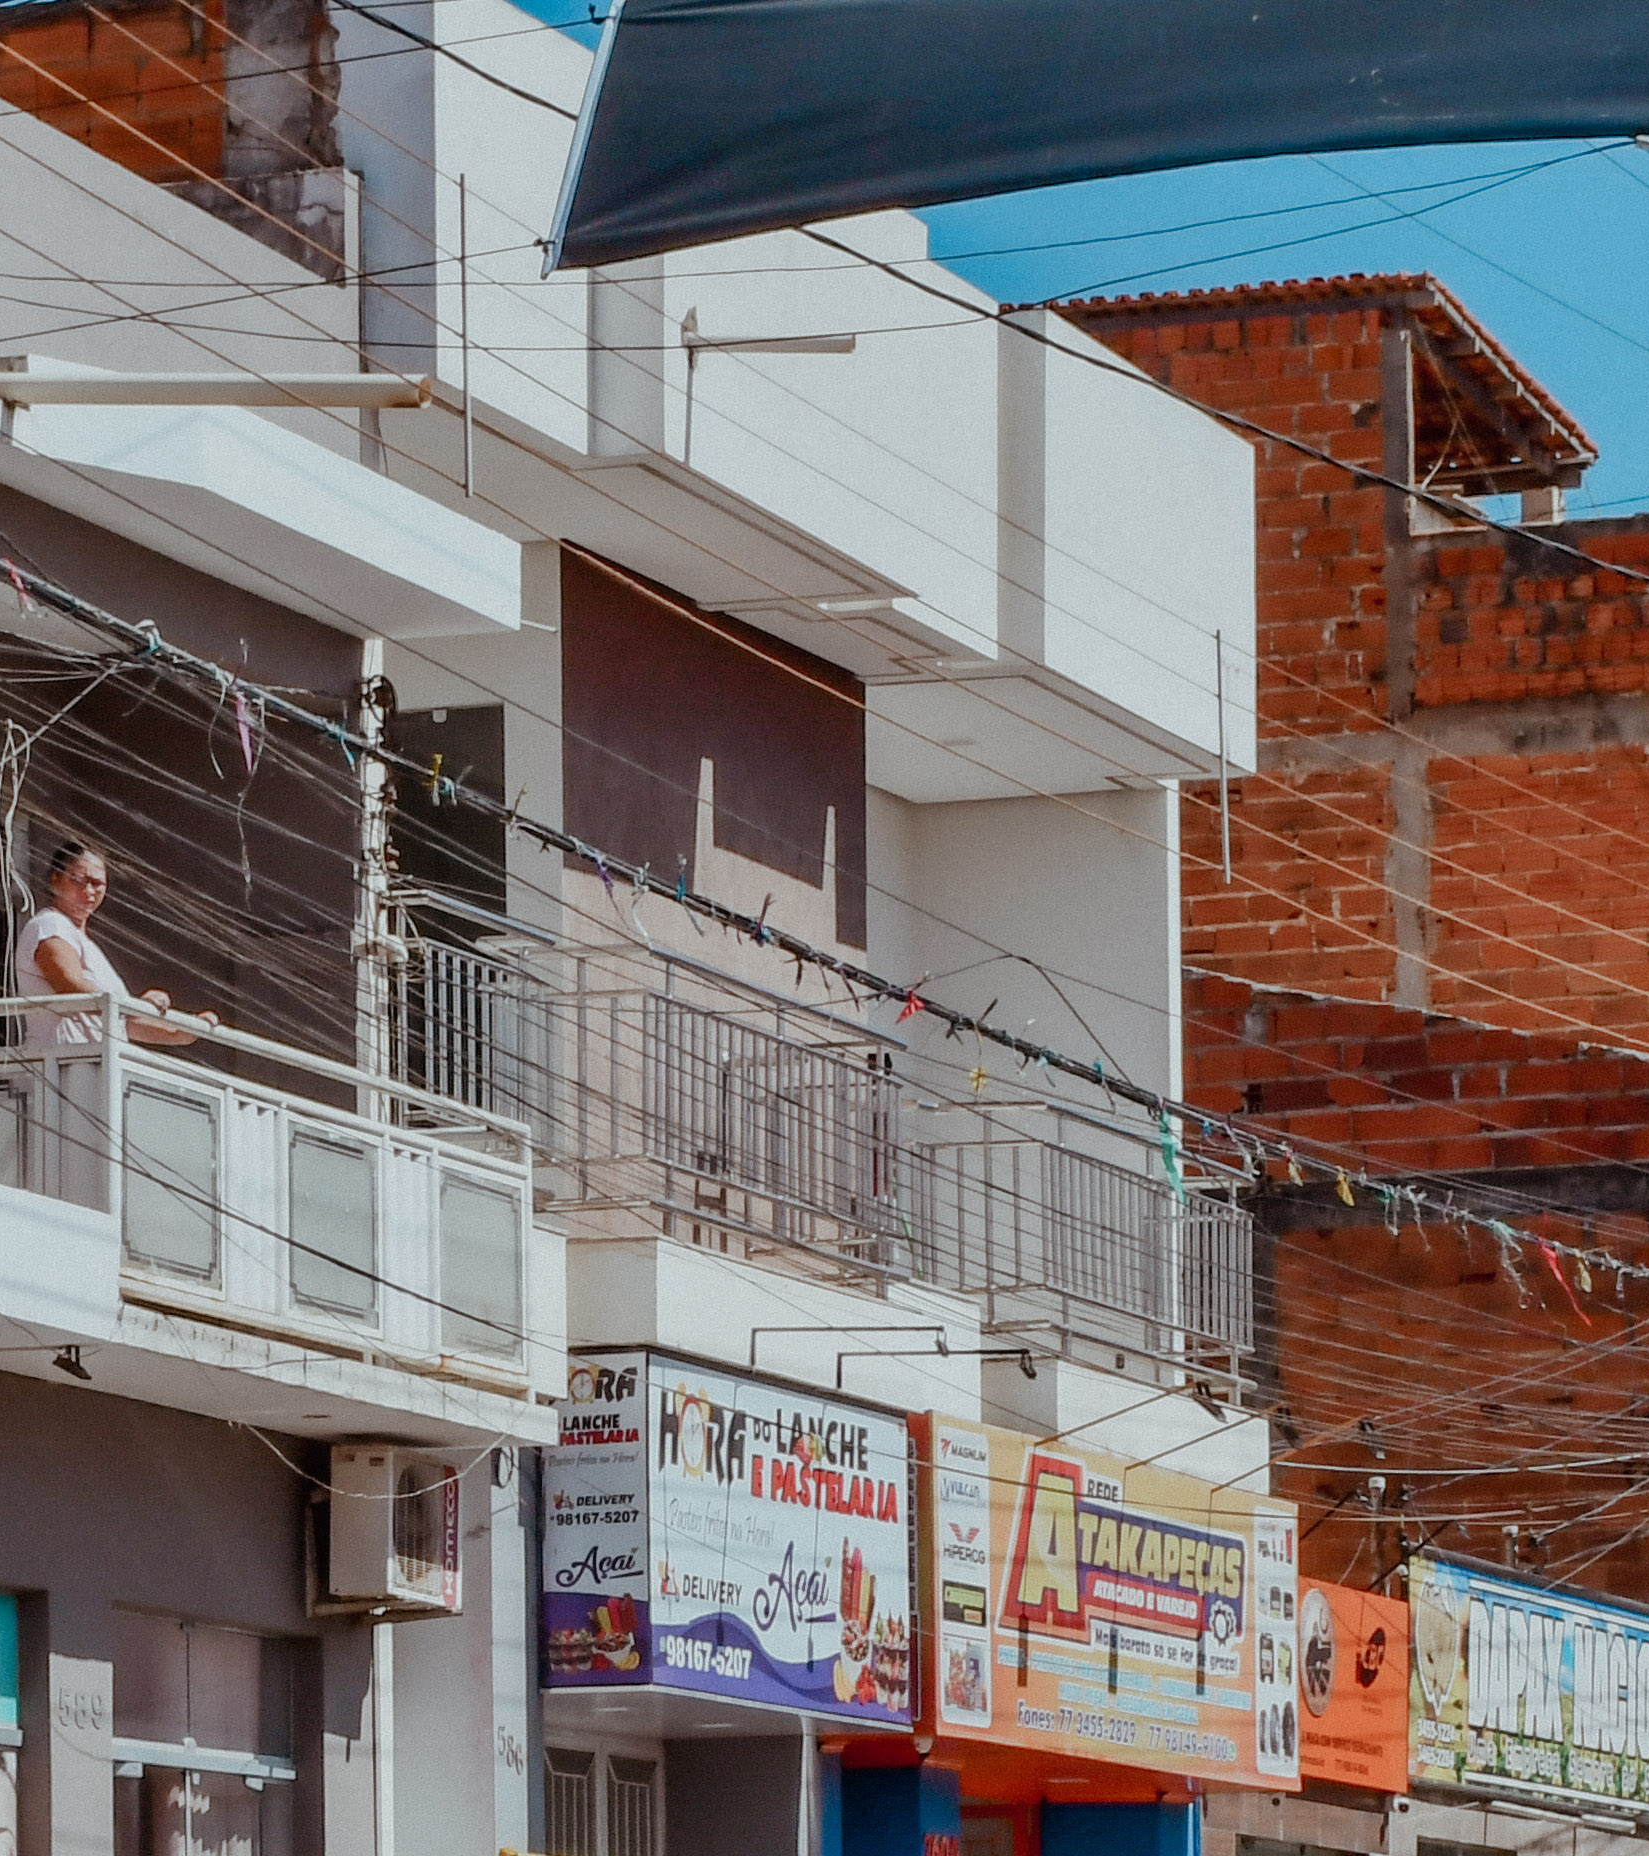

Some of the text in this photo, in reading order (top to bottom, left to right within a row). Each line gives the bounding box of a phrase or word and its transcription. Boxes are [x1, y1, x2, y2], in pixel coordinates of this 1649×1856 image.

[563, 1414, 620, 1431] LANCHE
[776, 1408, 868, 1471] LANCHE
[577, 1494, 635, 1506] DELIVERY
[770, 1458, 898, 1524] PASTELARIA
[1088, 1479, 1119, 1503] REDE
[556, 1510, 639, 1526] 98167-5207
[682, 1574, 742, 1606] DELIVERY
[666, 1635, 752, 1680] 98167-5207
[1059, 1708, 1073, 1735] 77
[497, 1726, 524, 1776] 586
